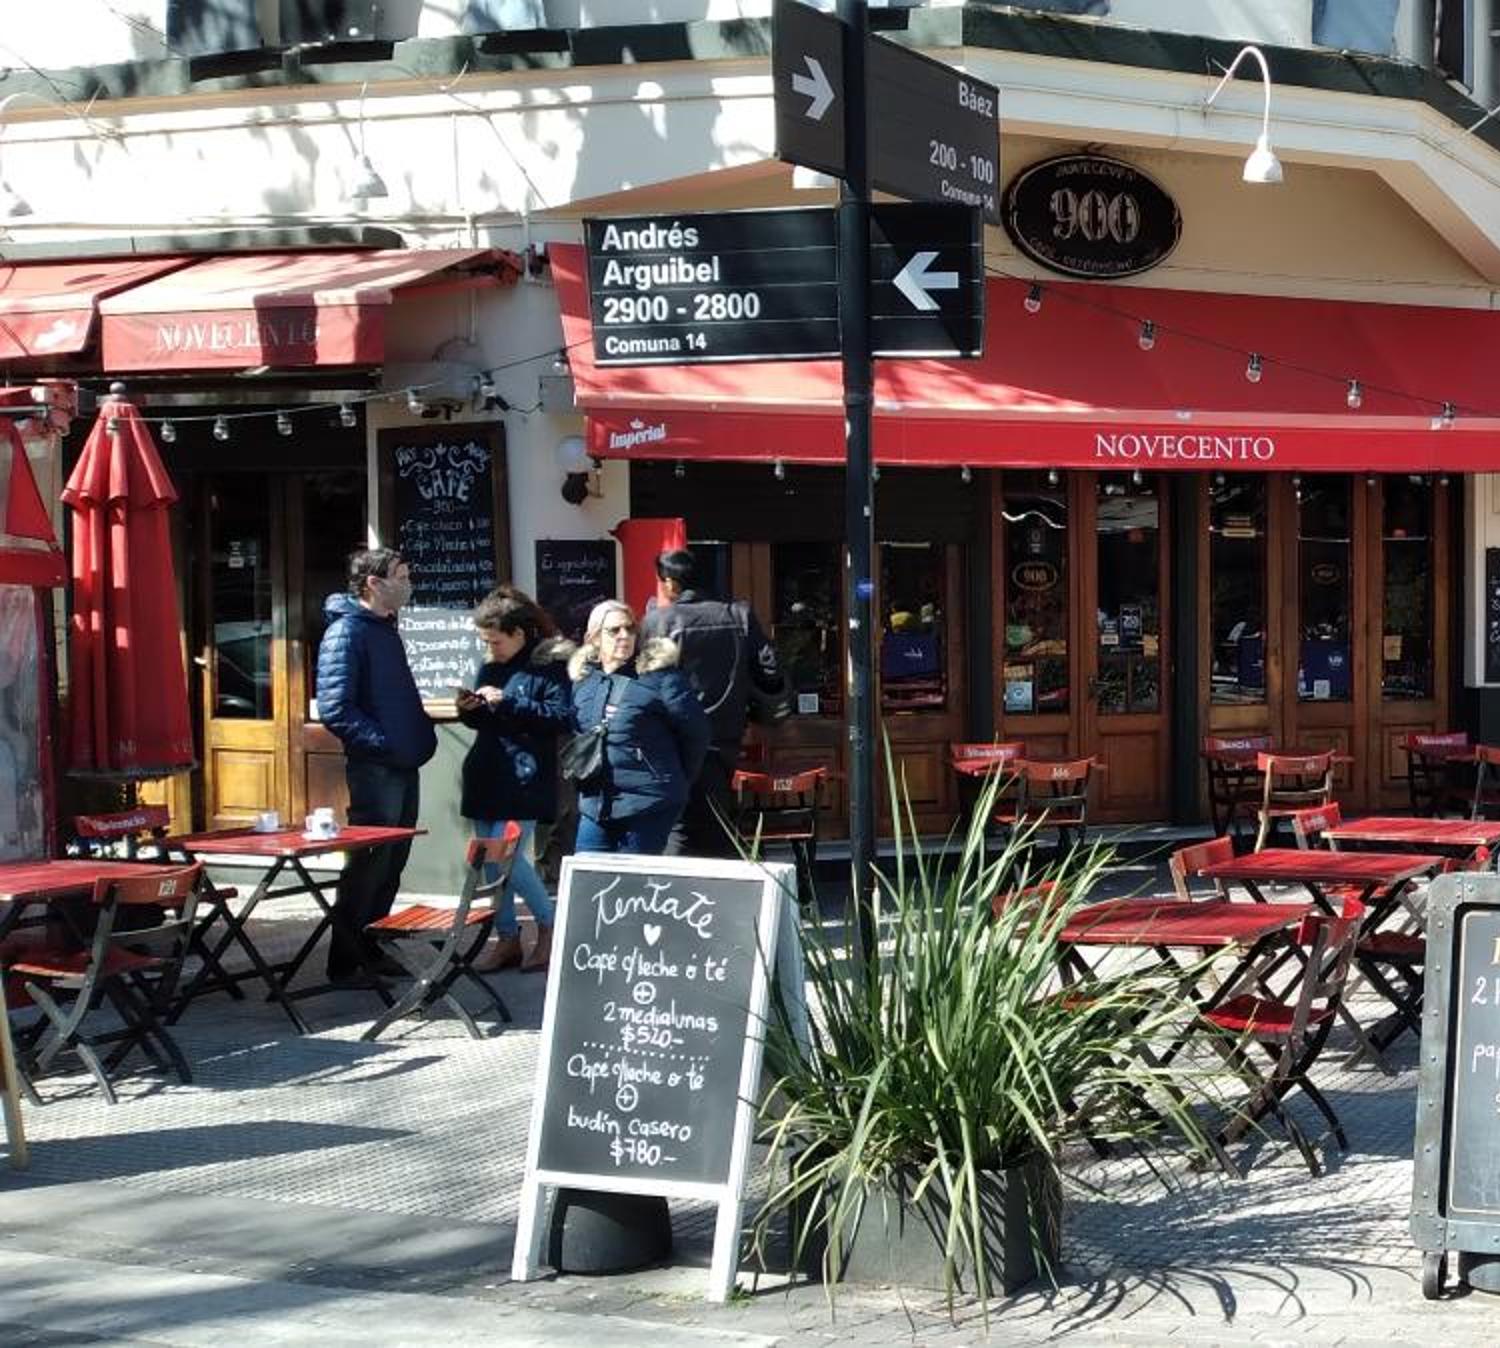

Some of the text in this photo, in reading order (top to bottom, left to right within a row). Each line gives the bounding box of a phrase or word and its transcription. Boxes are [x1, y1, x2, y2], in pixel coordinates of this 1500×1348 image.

[959, 81, 992, 117] Báez
[929, 140, 957, 171] 200
[970, 155, 993, 184] 100
[1050, 188, 1140, 244] 900
[602, 221, 699, 250] Andrés
[603, 256, 720, 290] Arguibel
[603, 296, 669, 323] 2900
[693, 292, 760, 321] 2800
[158, 320, 320, 351] NOVECENTO
[605, 332, 708, 354] Comuna 14
[610, 423, 667, 450] Imperial
[1095, 434, 1275, 460] NOVECENTO
[592, 875, 717, 940] Tentate
[573, 944, 618, 985] Café
[704, 955, 729, 982] té
[1471, 976, 1487, 1005] 2
[603, 999, 719, 1032] 2 medialunas
[686, 1062, 705, 1090] té
[567, 1104, 620, 1135] budín
